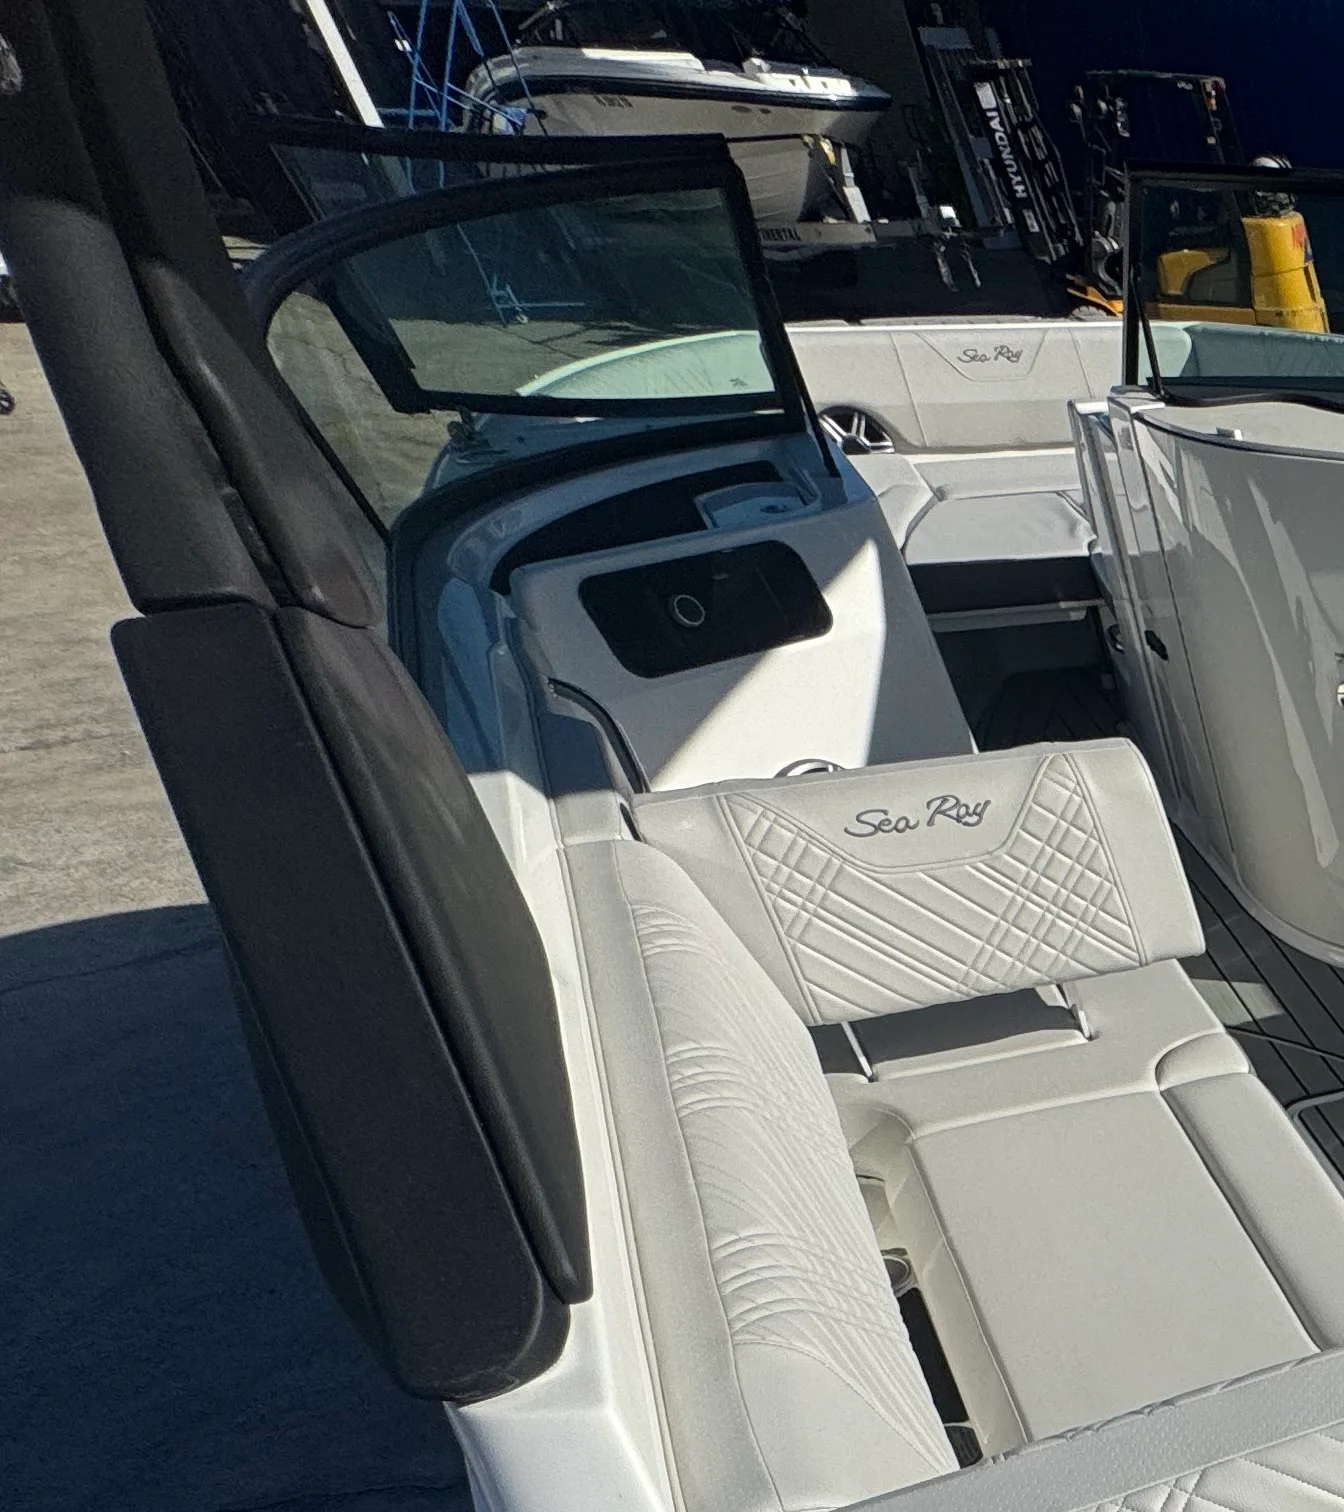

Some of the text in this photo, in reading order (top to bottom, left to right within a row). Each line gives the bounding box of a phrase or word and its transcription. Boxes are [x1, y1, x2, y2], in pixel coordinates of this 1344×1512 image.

[986, 109, 1028, 199] HYUNDAI
[957, 345, 1024, 363] Sea Ray
[843, 794, 992, 838] Sea Ray
